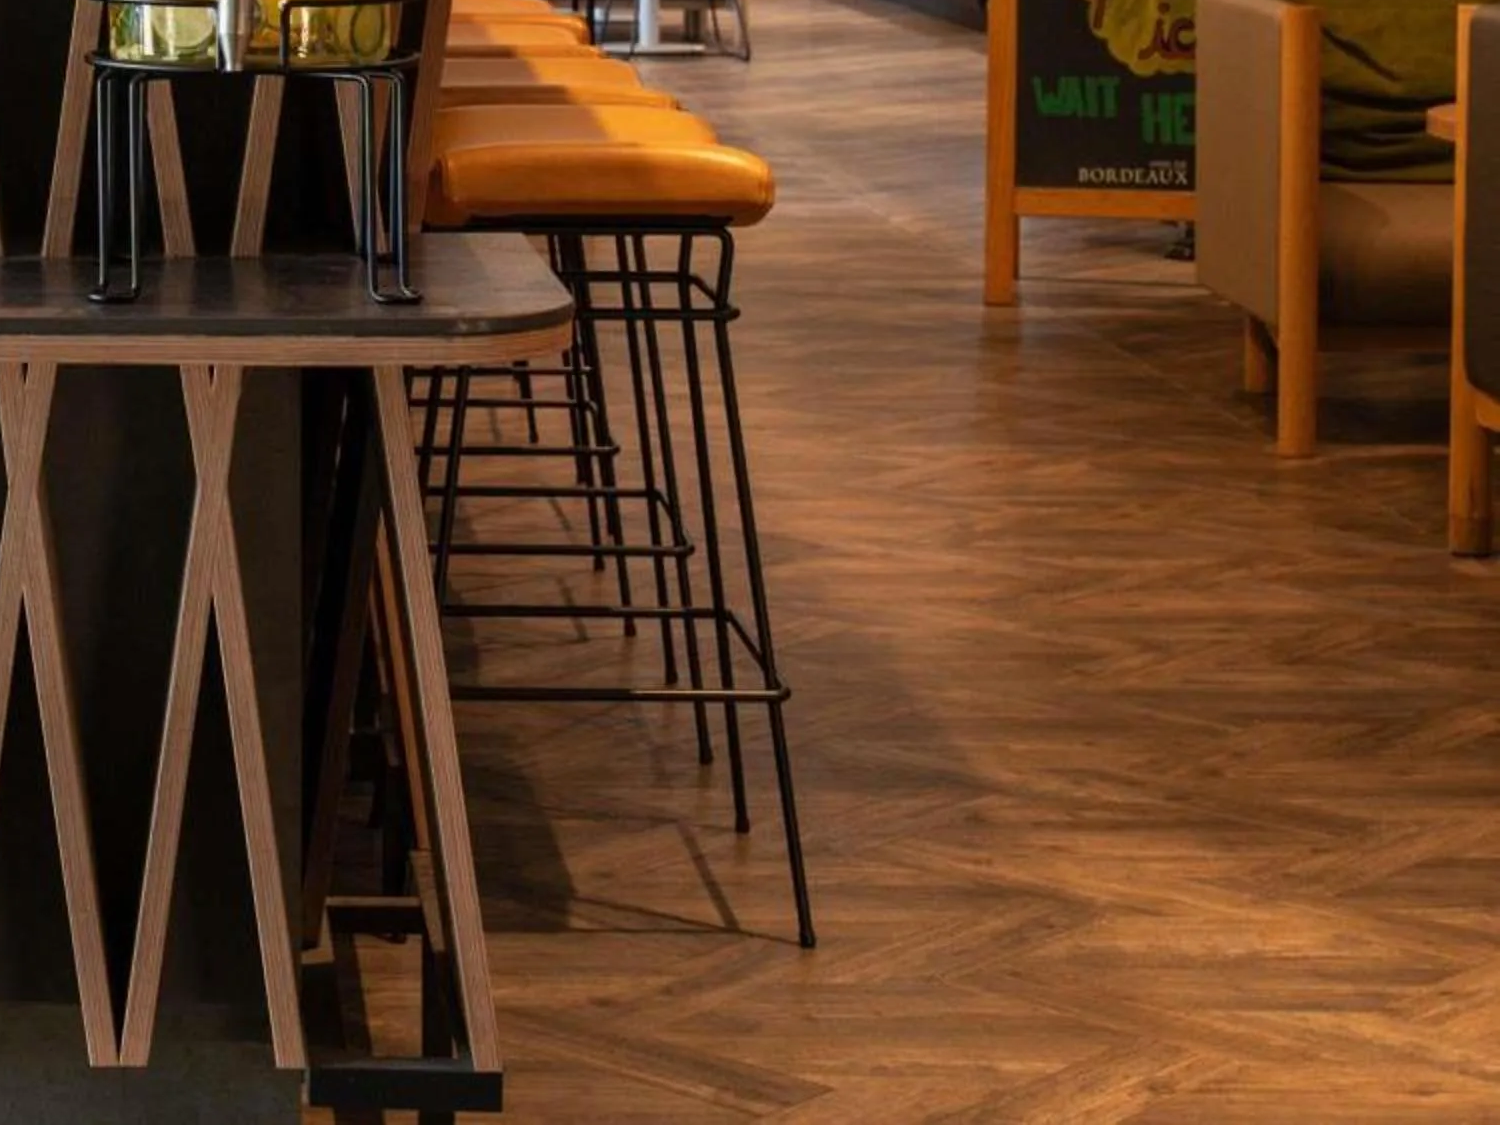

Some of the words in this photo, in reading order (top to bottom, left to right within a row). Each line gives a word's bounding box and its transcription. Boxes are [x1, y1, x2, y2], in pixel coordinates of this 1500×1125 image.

[1138, 2, 1196, 60] ic
[1032, 76, 1120, 118] WAIT
[1141, 93, 1196, 145] HE
[1078, 168, 1188, 184] BORDEAUX
